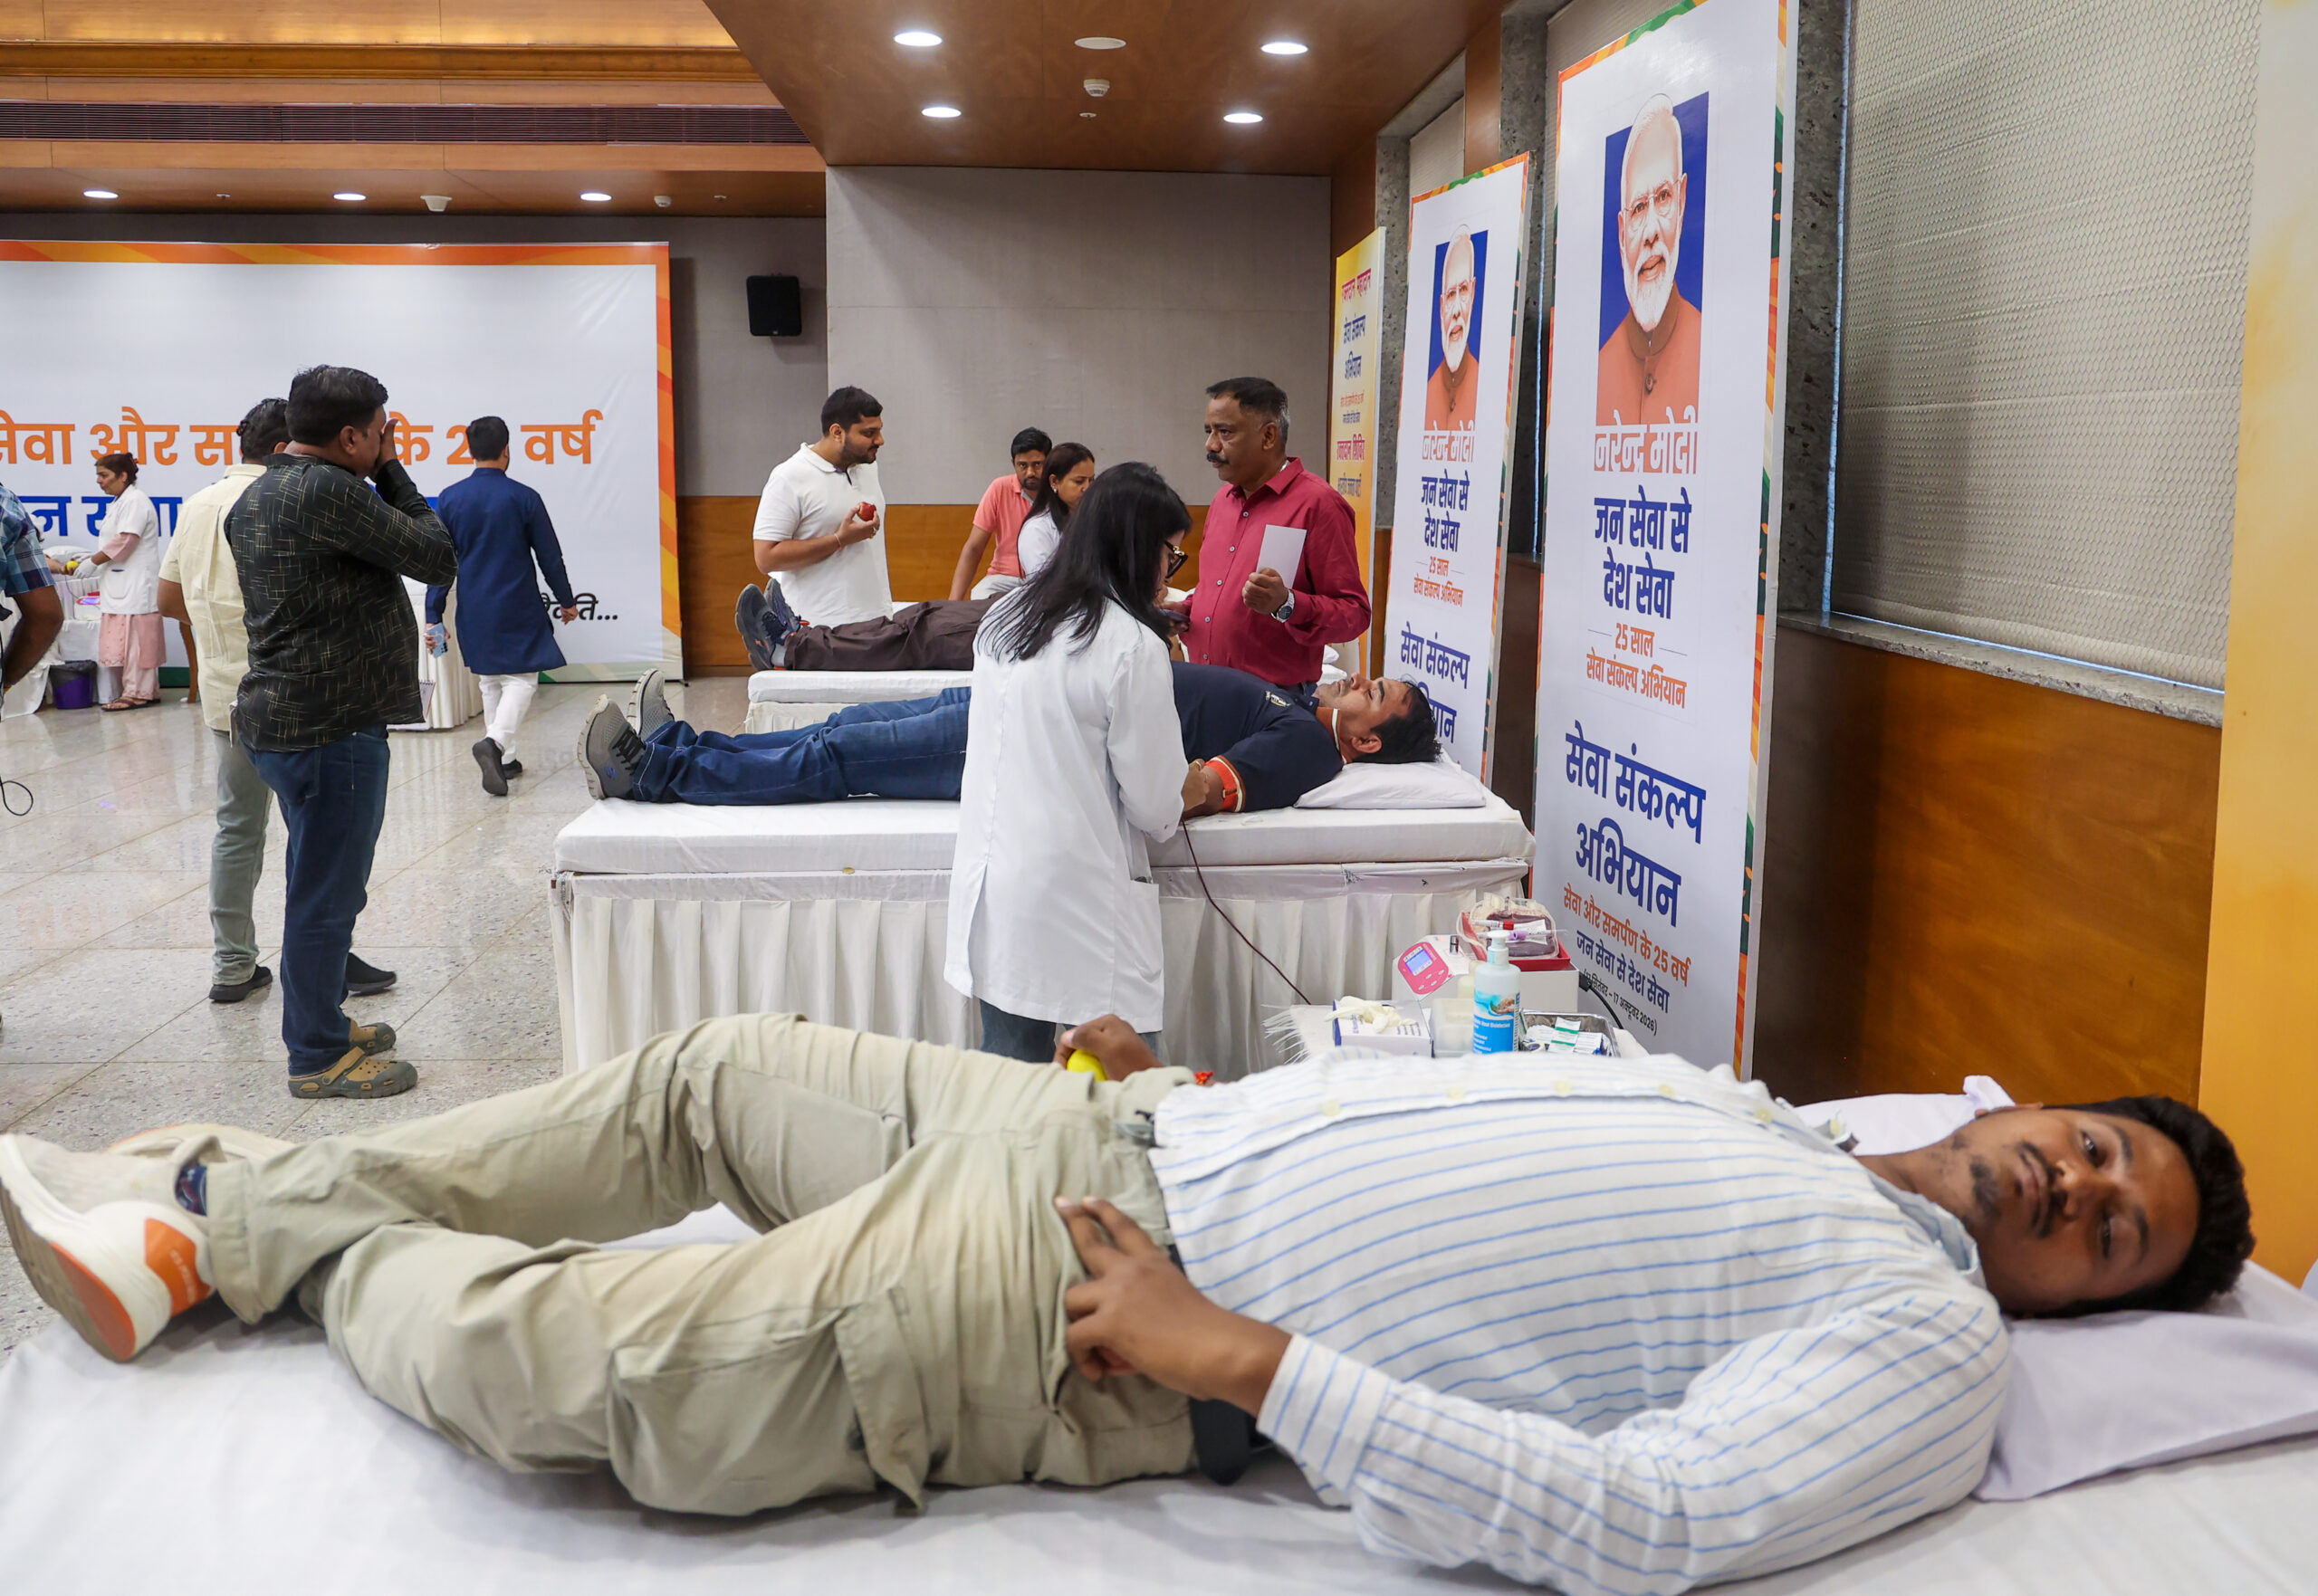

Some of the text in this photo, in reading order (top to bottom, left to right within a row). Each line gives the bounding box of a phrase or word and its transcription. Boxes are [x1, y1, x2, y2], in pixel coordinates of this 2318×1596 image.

[90, 406, 180, 465] और
[446, 425, 474, 465] 2
[521, 409, 604, 464] वर्ष
[1649, 406, 1699, 474] मोदी
[1421, 469, 1470, 511] जन सेवा से
[1595, 485, 1692, 553] जन सेवा से
[1424, 508, 1461, 552] देश सेवा
[1603, 546, 1675, 619] देश सेवा
[1401, 621, 1470, 689] सेवा संकल्प
[1615, 623, 1655, 657] 25 साल
[1586, 646, 1687, 709] सेवा संकल्प अभियान
[1566, 720, 1706, 845] सेवा संकल्प
[1576, 817, 1681, 928] अभियान
[1564, 883, 1691, 988] सेवा और समर्पण के 25 वर्ष
[1576, 930, 1671, 1014] जन सेवा से देश सेवा
[1614, 992, 1619, 1005] 17
[1640, 1011, 1658, 1036] 2026)
